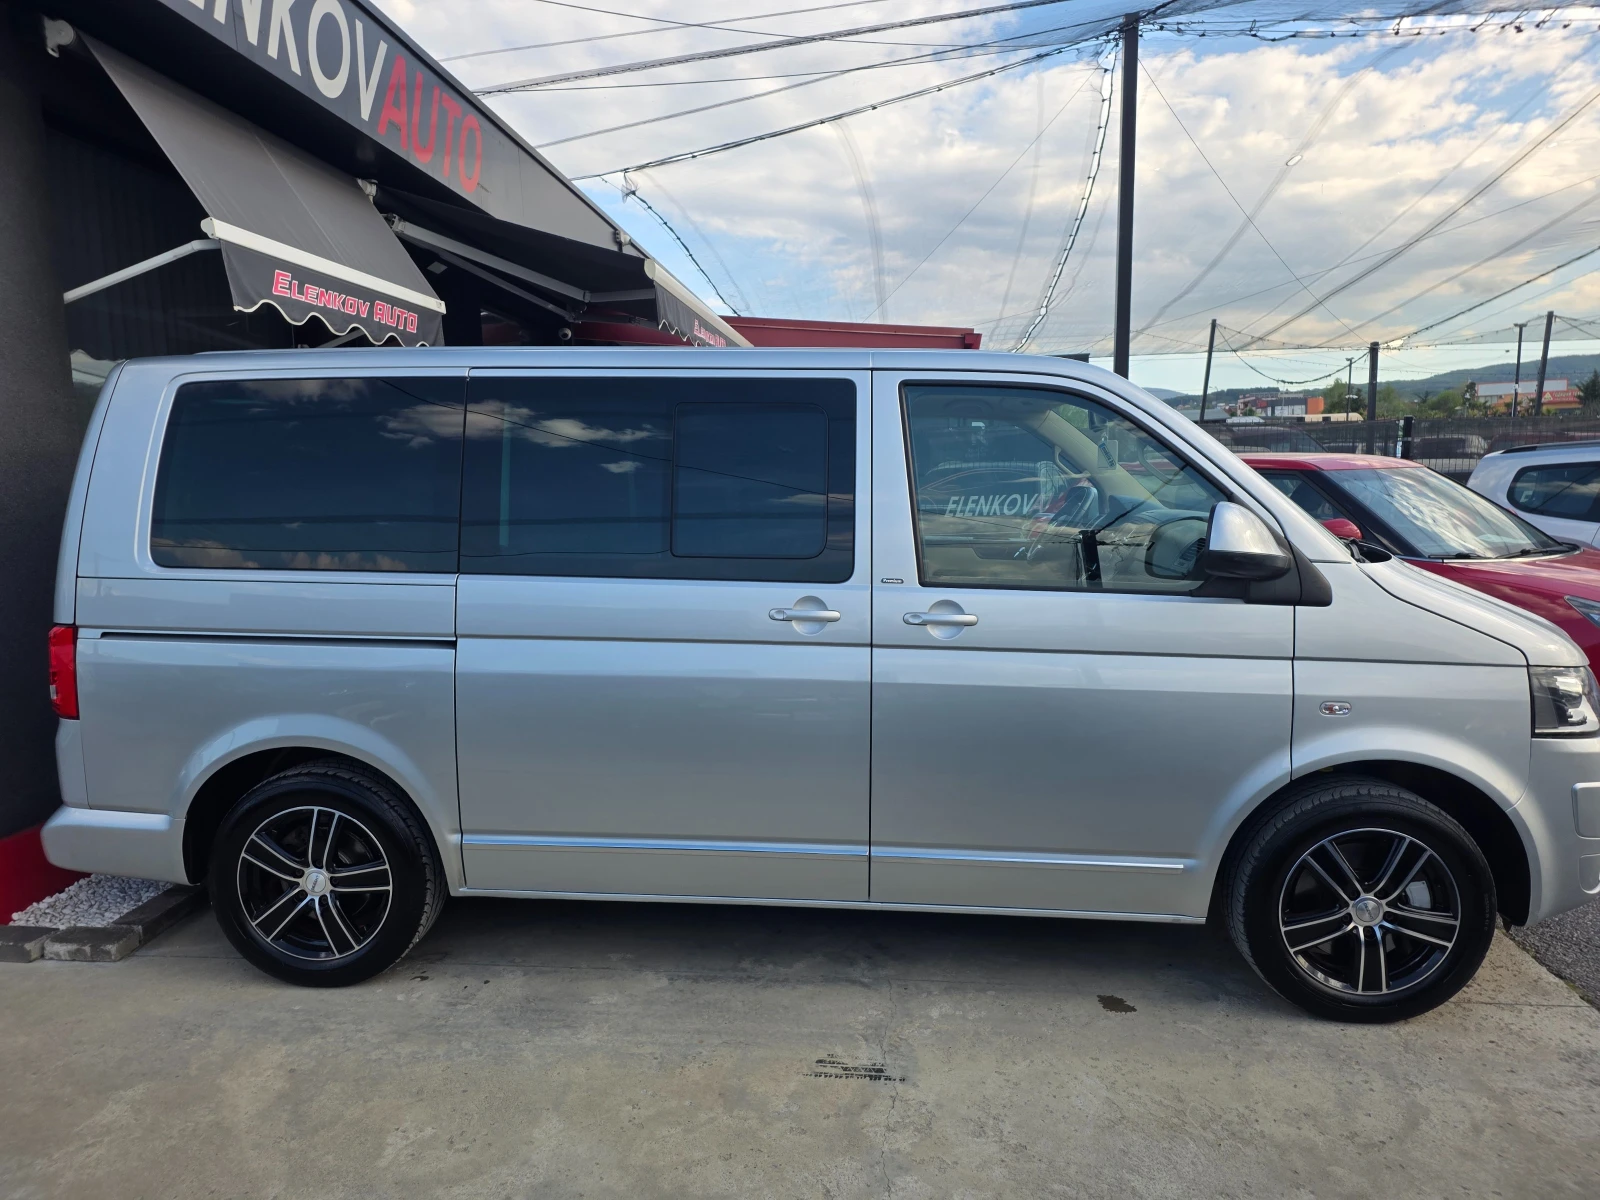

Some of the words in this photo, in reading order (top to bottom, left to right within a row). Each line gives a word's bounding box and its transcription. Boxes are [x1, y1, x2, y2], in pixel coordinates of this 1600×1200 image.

[186, 0, 388, 122] KOV
[377, 54, 483, 194] AUTO
[272, 269, 370, 317] ELENKOV
[373, 300, 418, 333] AUTO
[944, 493, 1039, 517] ELENKOV
